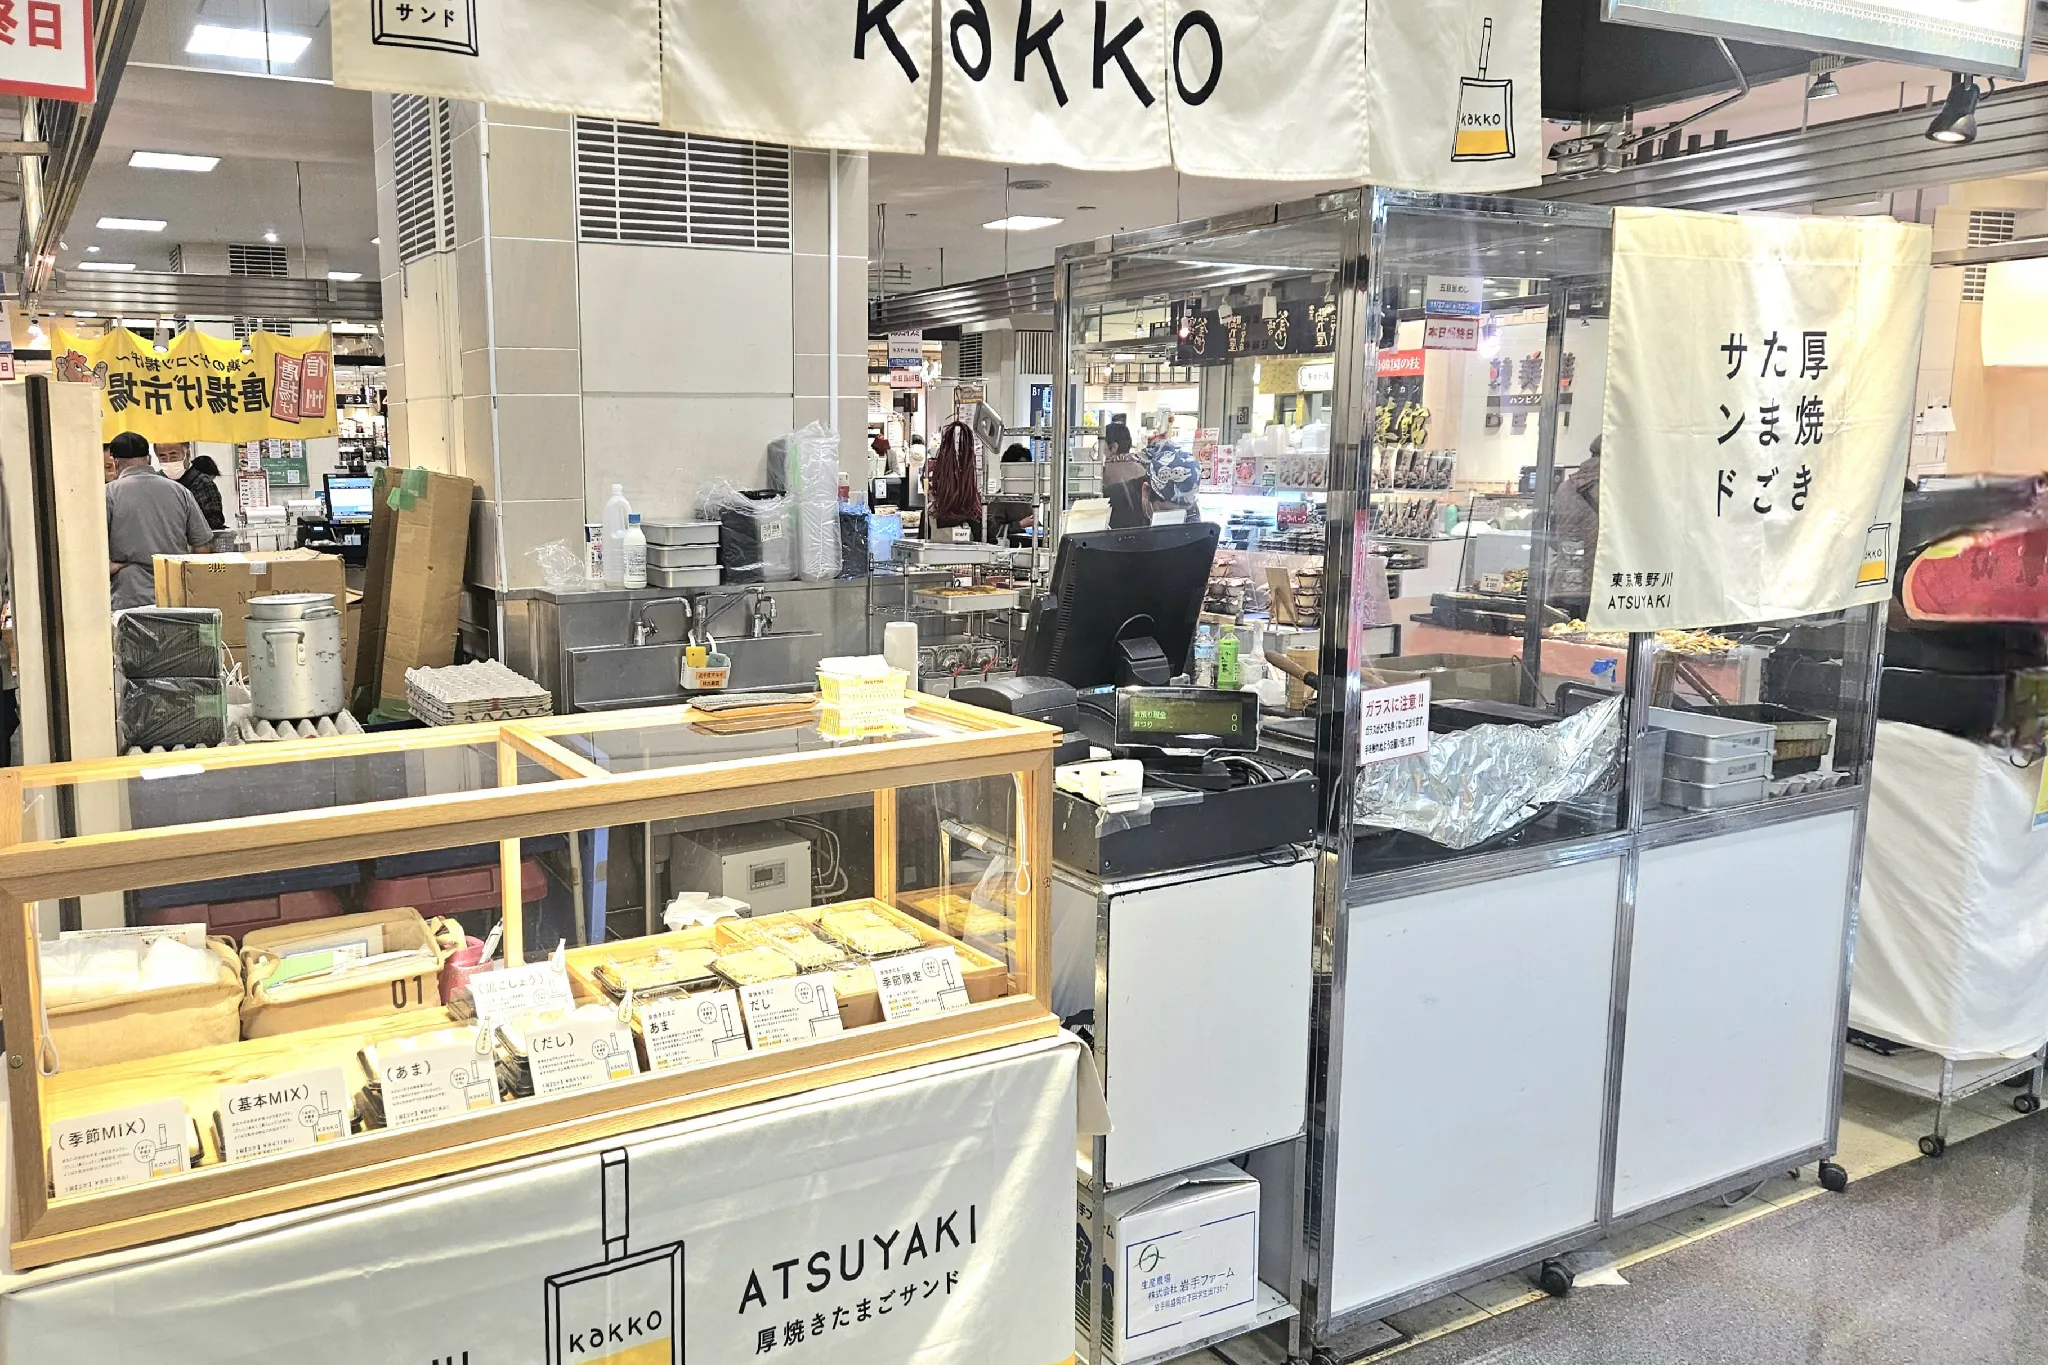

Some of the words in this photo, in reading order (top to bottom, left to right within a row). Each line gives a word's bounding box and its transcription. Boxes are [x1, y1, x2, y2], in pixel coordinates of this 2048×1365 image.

[396, 3, 454, 27] サンド
[1717, 332, 1748, 517] サンド
[1753, 330, 1788, 514] たまご
[1791, 331, 1828, 512] 厚焼き
[1607, 594, 1671, 610] ATSUYAKI
[391, 974, 423, 1008] 01
[882, 970, 923, 988] 季節限定
[749, 998, 771, 1012] だし
[650, 1020, 670, 1035] あま
[738, 1204, 976, 1315] ATSUYAKI
[756, 1270, 959, 1355] 厚焼きたまごサンド
